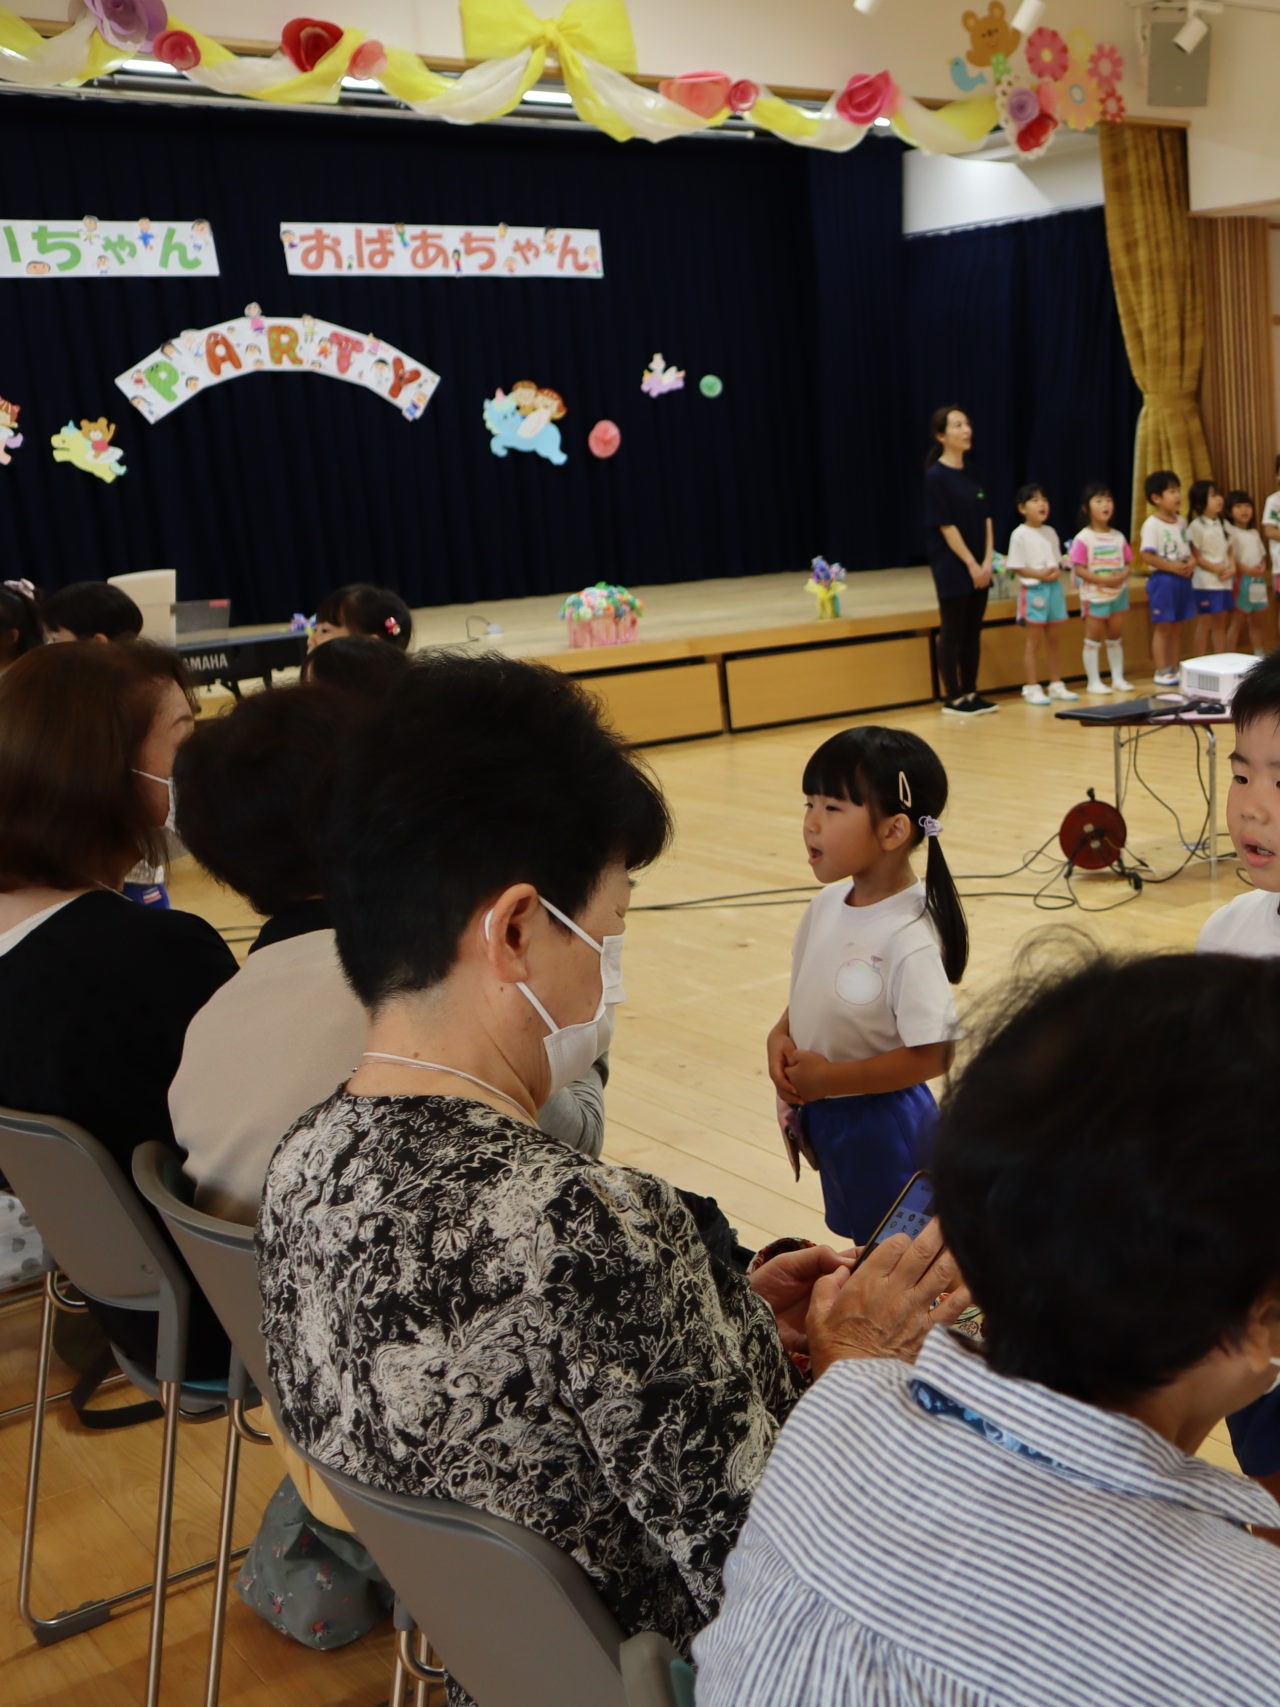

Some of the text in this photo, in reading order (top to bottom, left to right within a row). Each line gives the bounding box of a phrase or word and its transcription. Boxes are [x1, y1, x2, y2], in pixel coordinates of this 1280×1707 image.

[300, 227, 590, 271] おばあちゃん
[143, 324, 422, 403] PARTY
